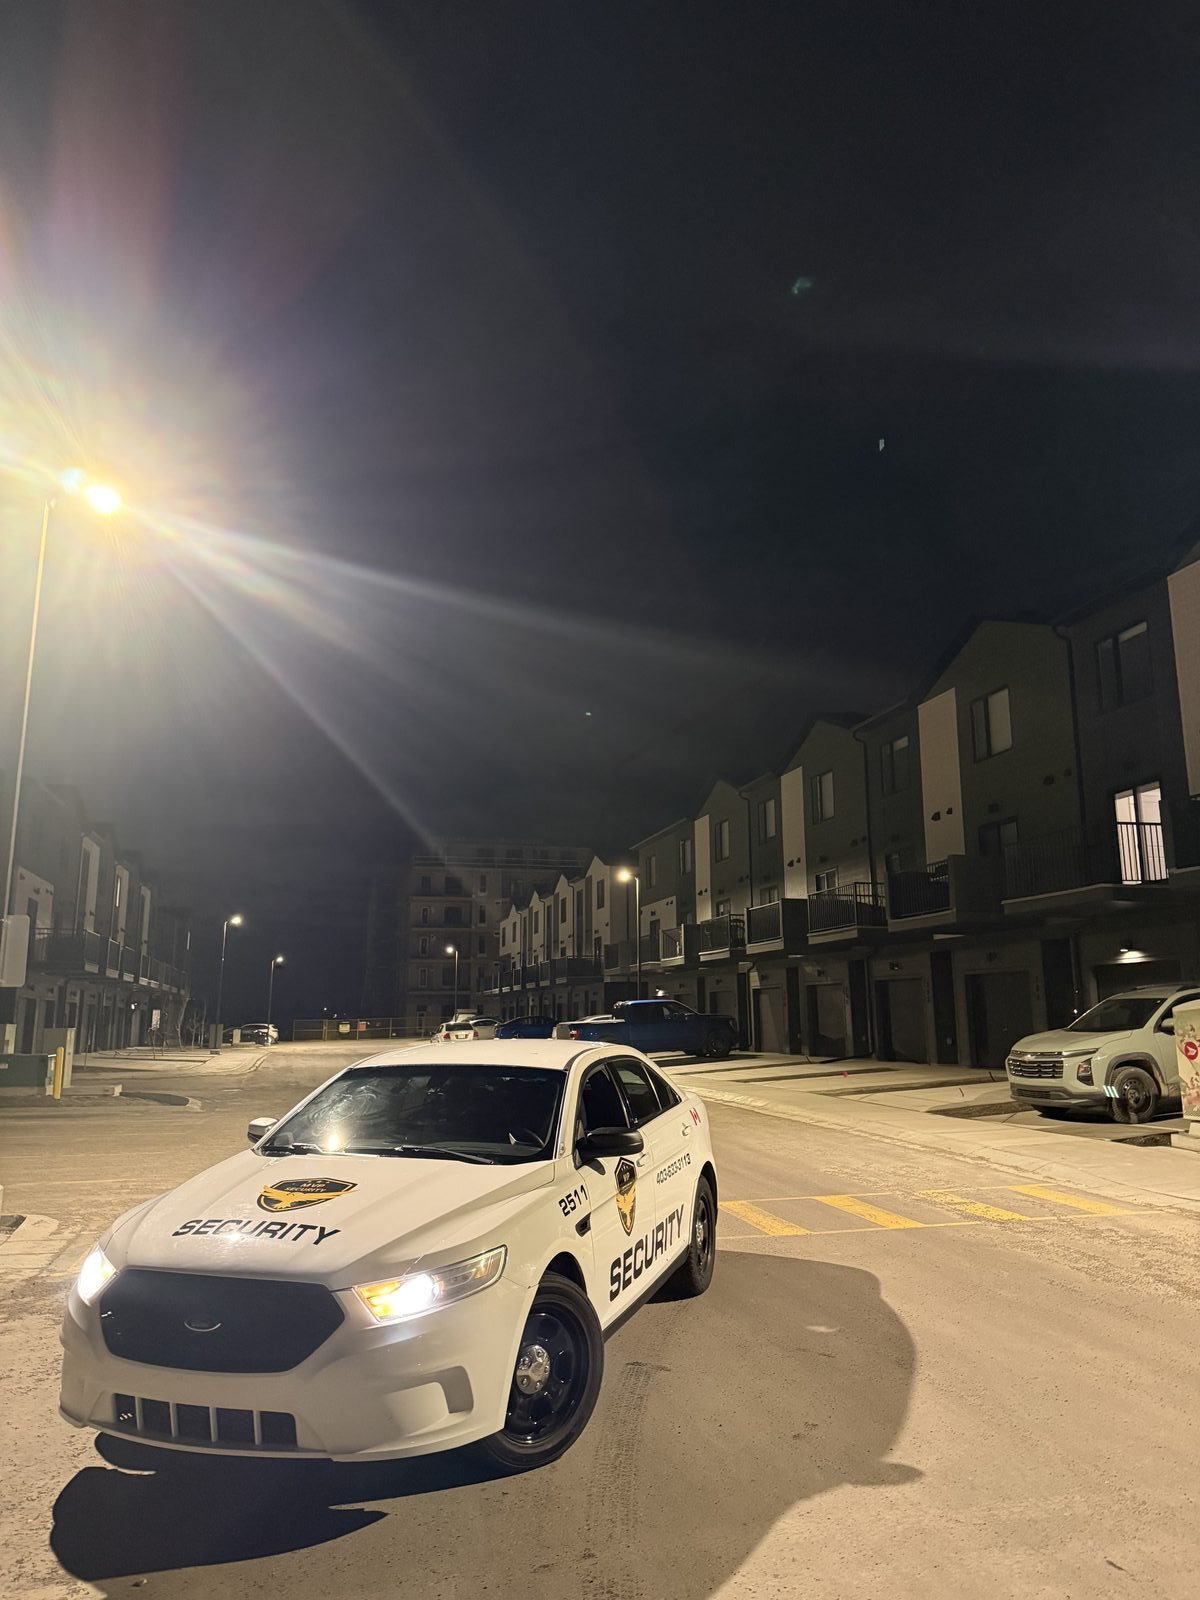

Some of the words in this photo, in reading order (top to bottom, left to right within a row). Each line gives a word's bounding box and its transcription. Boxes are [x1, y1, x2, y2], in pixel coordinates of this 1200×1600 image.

[559, 1185, 588, 1217] 2511
[172, 1219, 341, 1246] SECURITY
[609, 1204, 684, 1302] SECURITY
